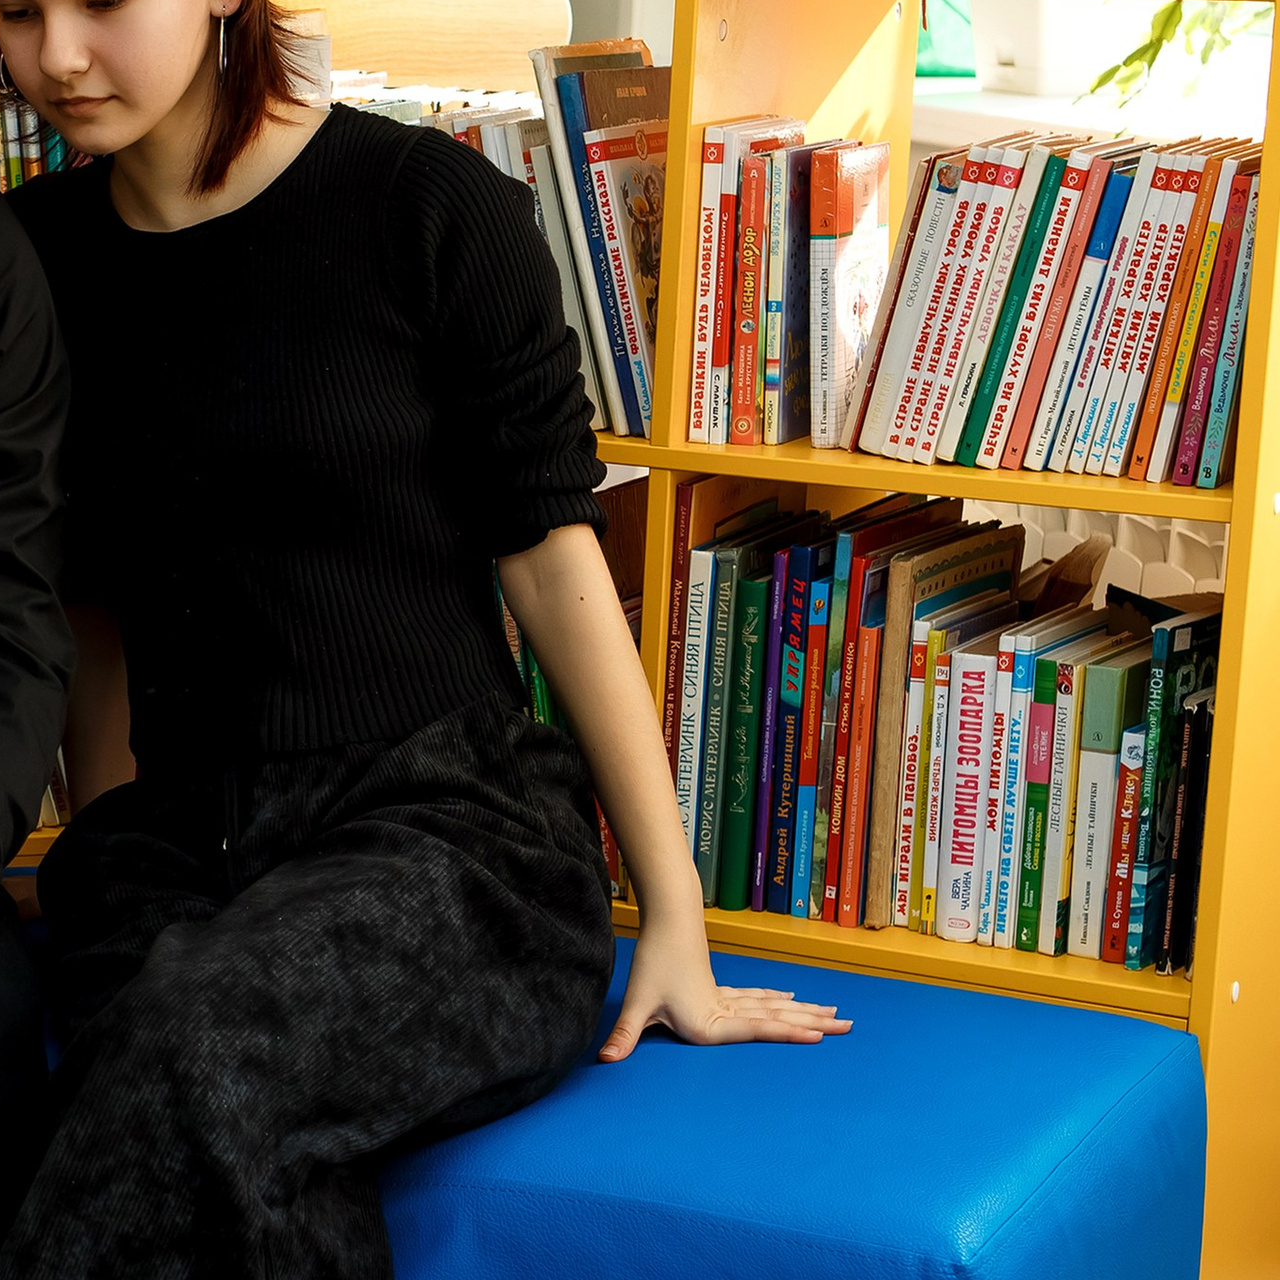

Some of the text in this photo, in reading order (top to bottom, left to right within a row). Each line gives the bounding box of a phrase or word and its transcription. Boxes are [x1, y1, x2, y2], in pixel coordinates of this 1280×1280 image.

[595, 170, 639, 355] ФАНТАСТИЧЕСКИЕ РАССКАЗЫ
[698, 304, 709, 342] БУДЬ
[699, 206, 714, 298] ЧЕЛОВЕКОМ!
[741, 227, 761, 318] ЛЕСНОЙ ДОЗОР
[984, 196, 1072, 456] ВЕЧЕРА НА ХУТОРЕ БЛИЗ ДИКАНЬКИ
[1099, 220, 1152, 370] МЯГКИЙ ХАРАКТЕР
[785, 576, 806, 694] УПРЯМЕЦ
[699, 581, 731, 854] МОРИС МЕТЕРЛИНК СИНЯЯ ПТИЦА
[950, 670, 986, 866] ПИТОМЦЫ ЗООПАРКА
[773, 714, 796, 885] Андрей Кутерницкий
[830, 756, 845, 834] КОШКИН ДОМ
